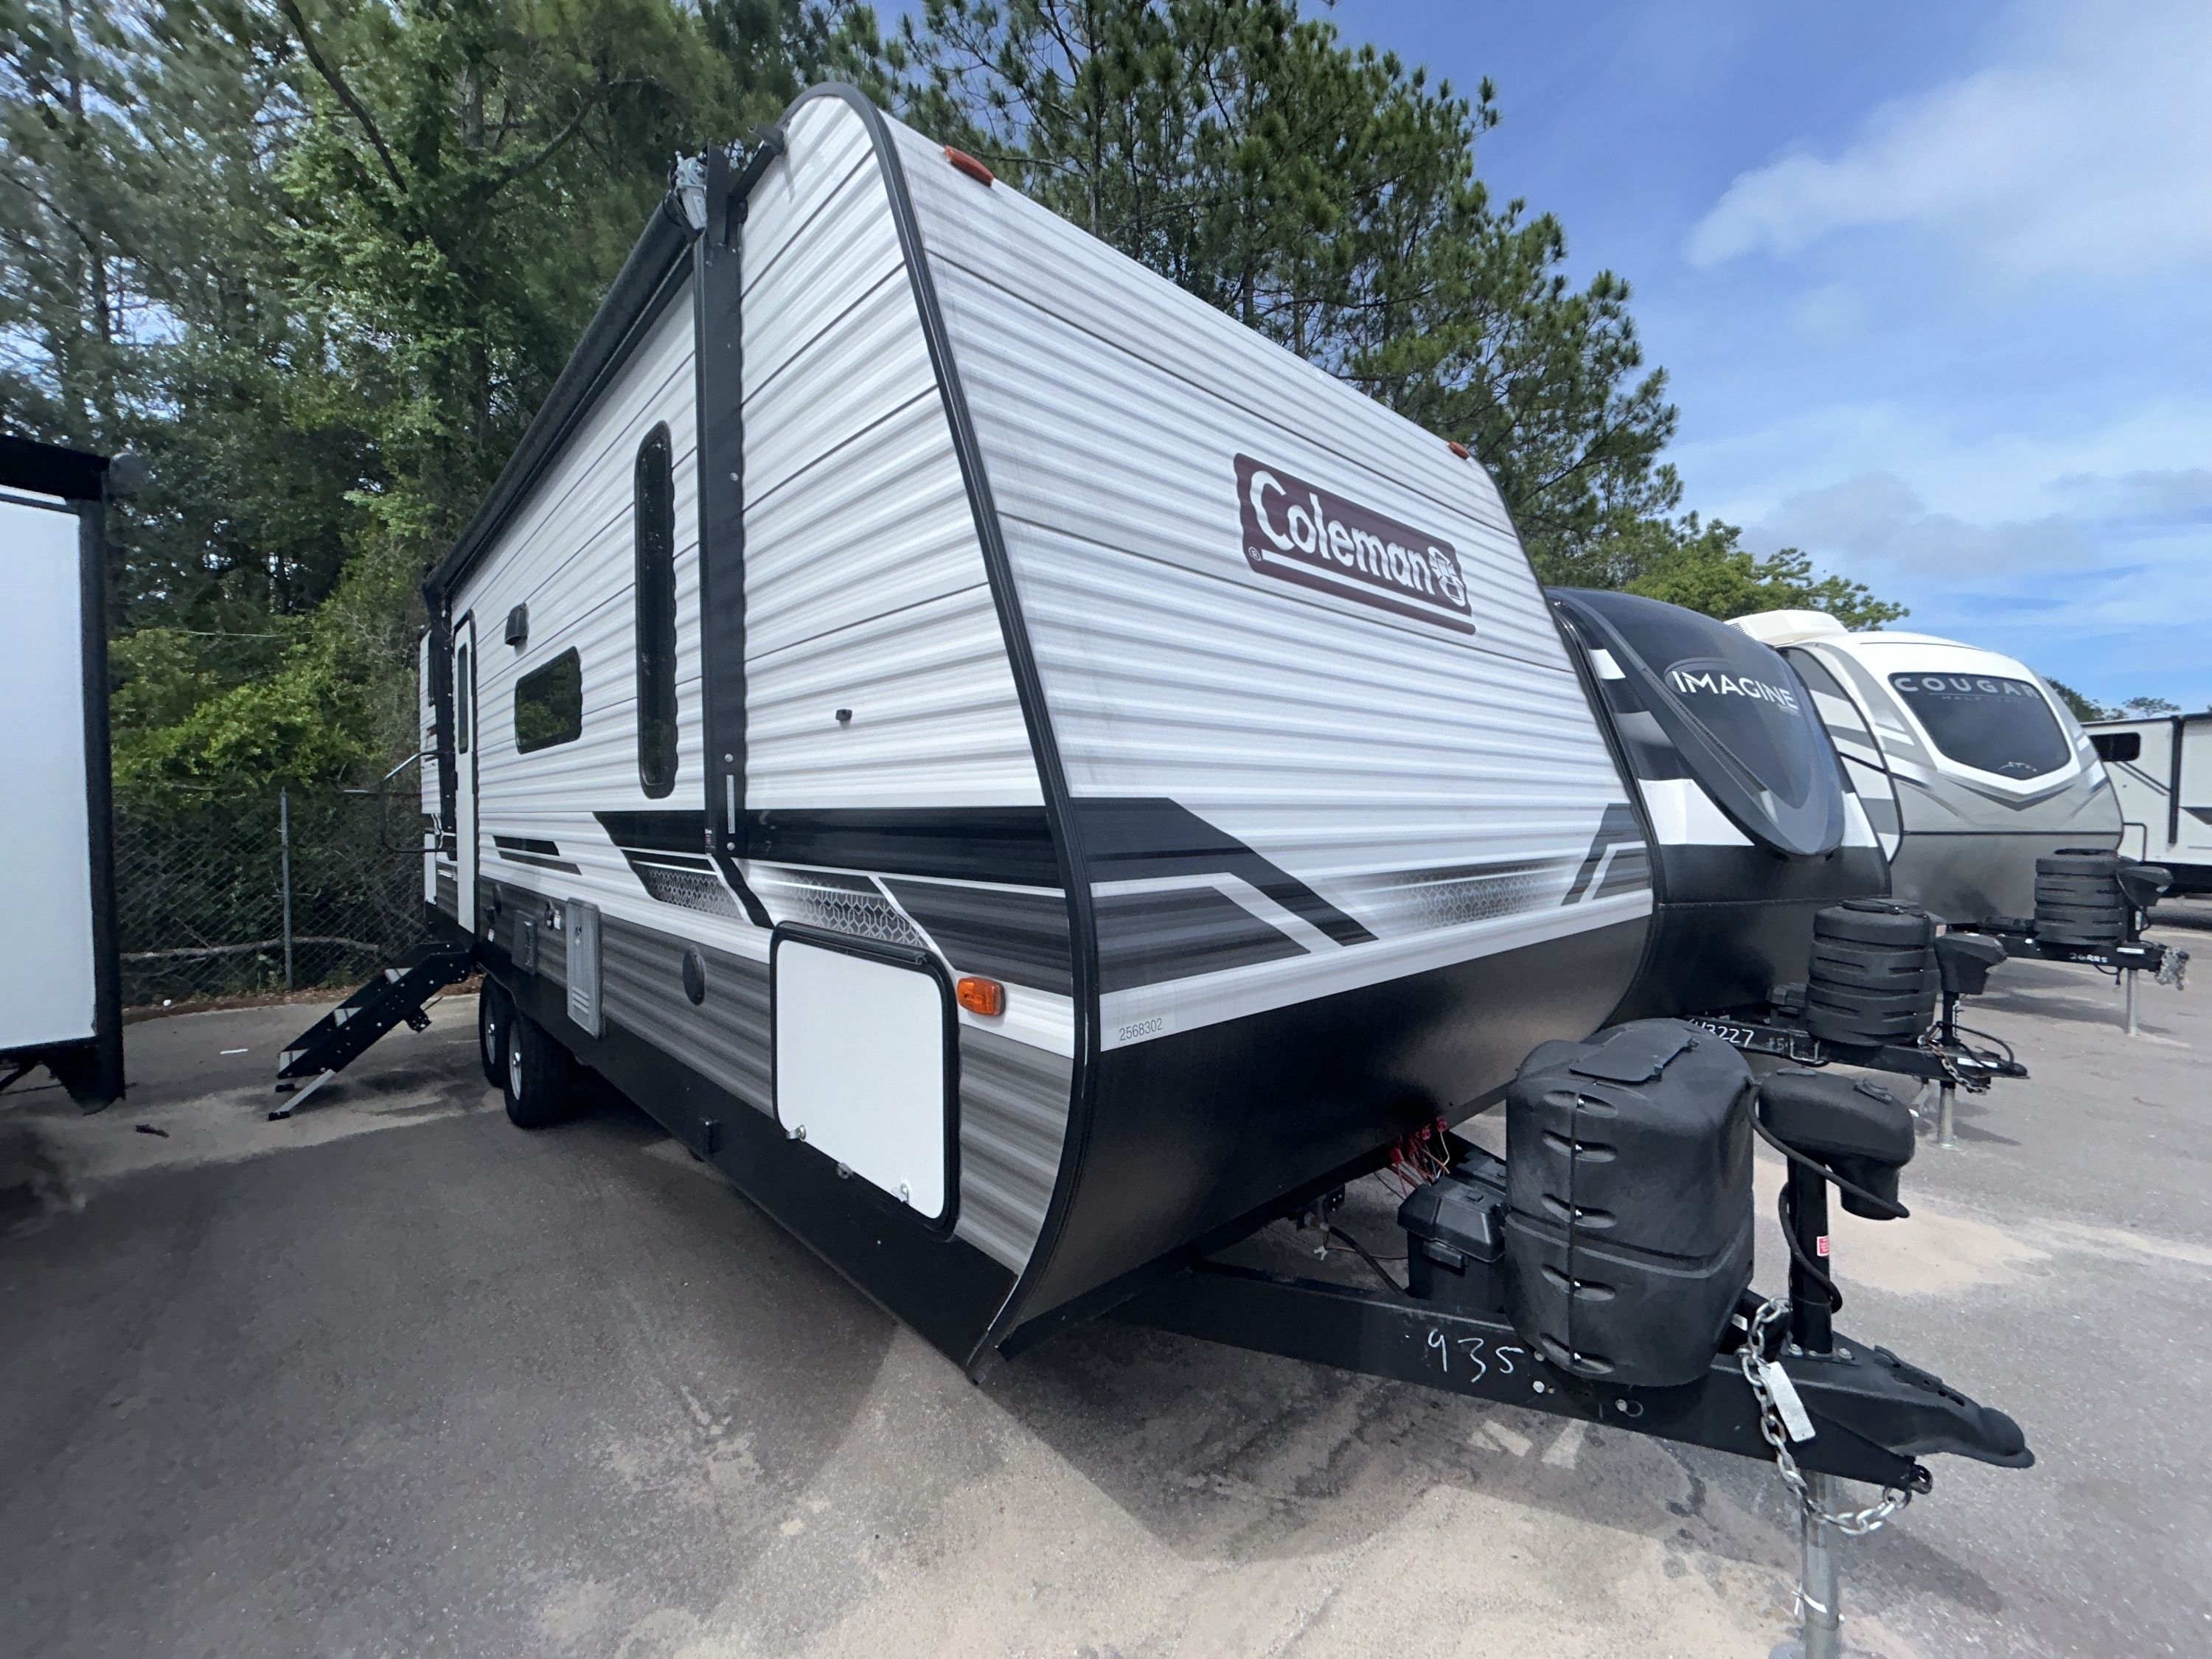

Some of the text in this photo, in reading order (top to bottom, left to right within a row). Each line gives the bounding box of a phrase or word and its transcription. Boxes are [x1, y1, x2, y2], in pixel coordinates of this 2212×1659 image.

[1250, 470, 1435, 595] Coleman
[1672, 670, 1799, 710] IMAGINE
[1894, 677, 2040, 699] COUGAR
[1119, 1018, 1163, 1041] 2568302
[1427, 1329, 1524, 1383] 935
